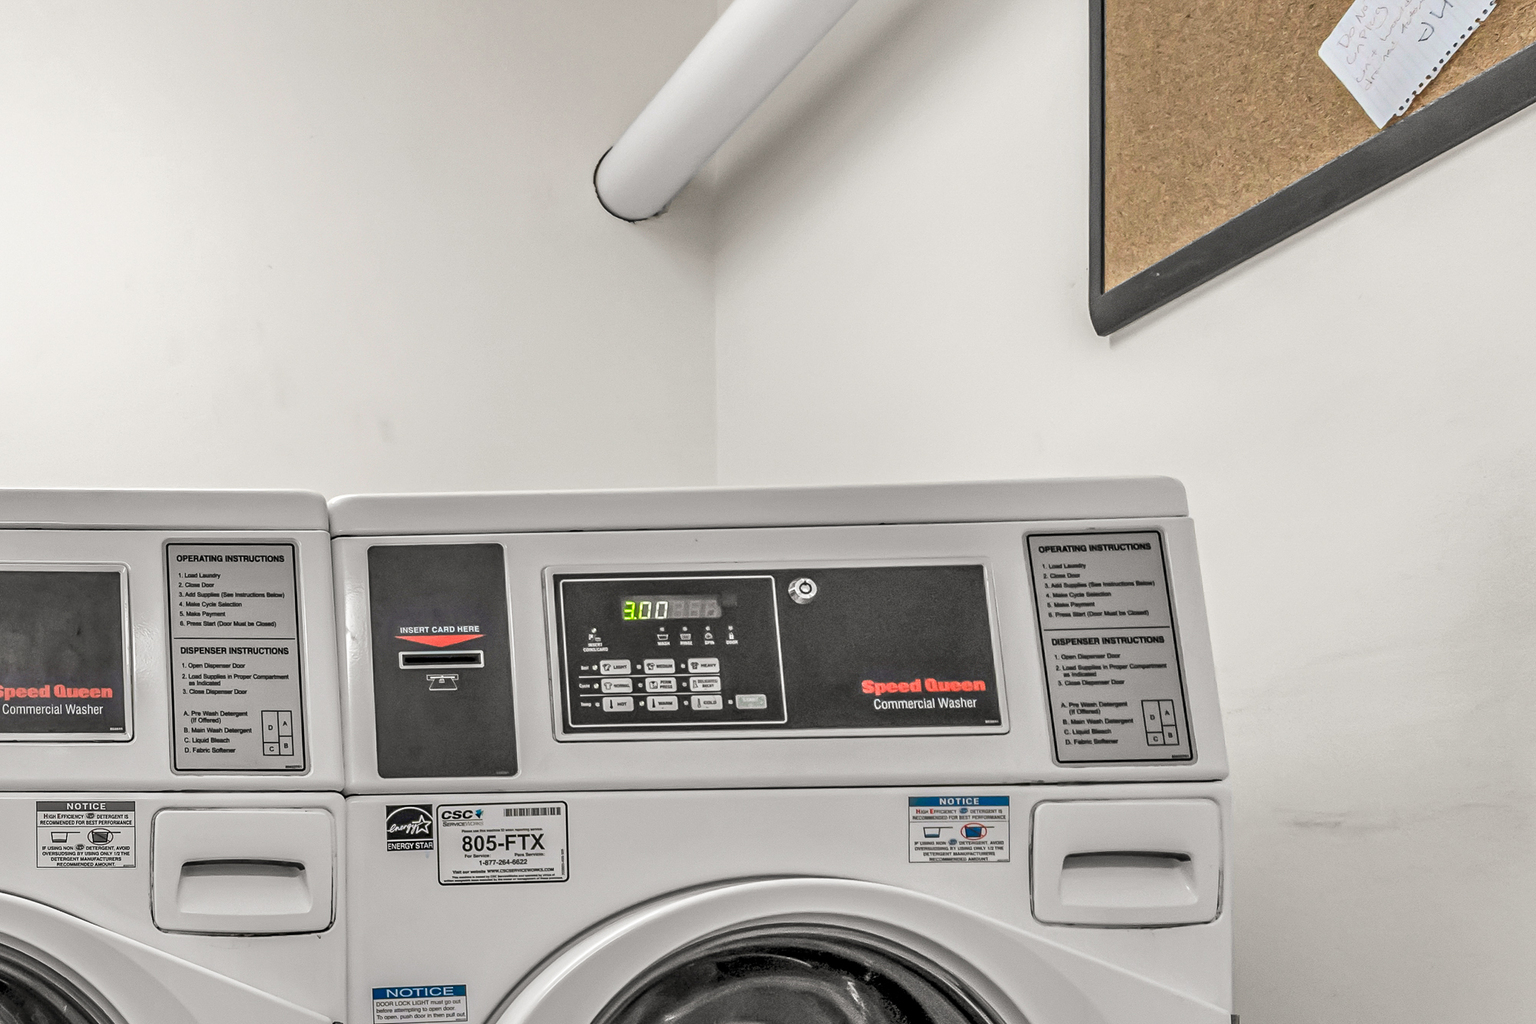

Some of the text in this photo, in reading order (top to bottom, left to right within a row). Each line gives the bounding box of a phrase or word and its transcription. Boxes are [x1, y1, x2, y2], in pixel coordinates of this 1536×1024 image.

[1038, 543, 1152, 553] OPERATING INSTRUCTIONS
[623, 601, 669, 620] 3.00
[457, 625, 480, 633] HERE
[1052, 636, 1164, 646] DISPENSER INSTRUCTIONS
[53, 684, 113, 699] Queen
[862, 678, 986, 696] Speed Queen
[873, 697, 977, 710] Commercial Washer
[2, 704, 103, 715] Commercial Washer
[441, 809, 474, 820] CSC
[388, 842, 414, 850] ENERGY
[462, 834, 545, 852] 805-FTX
[386, 986, 454, 998] NOTICE
